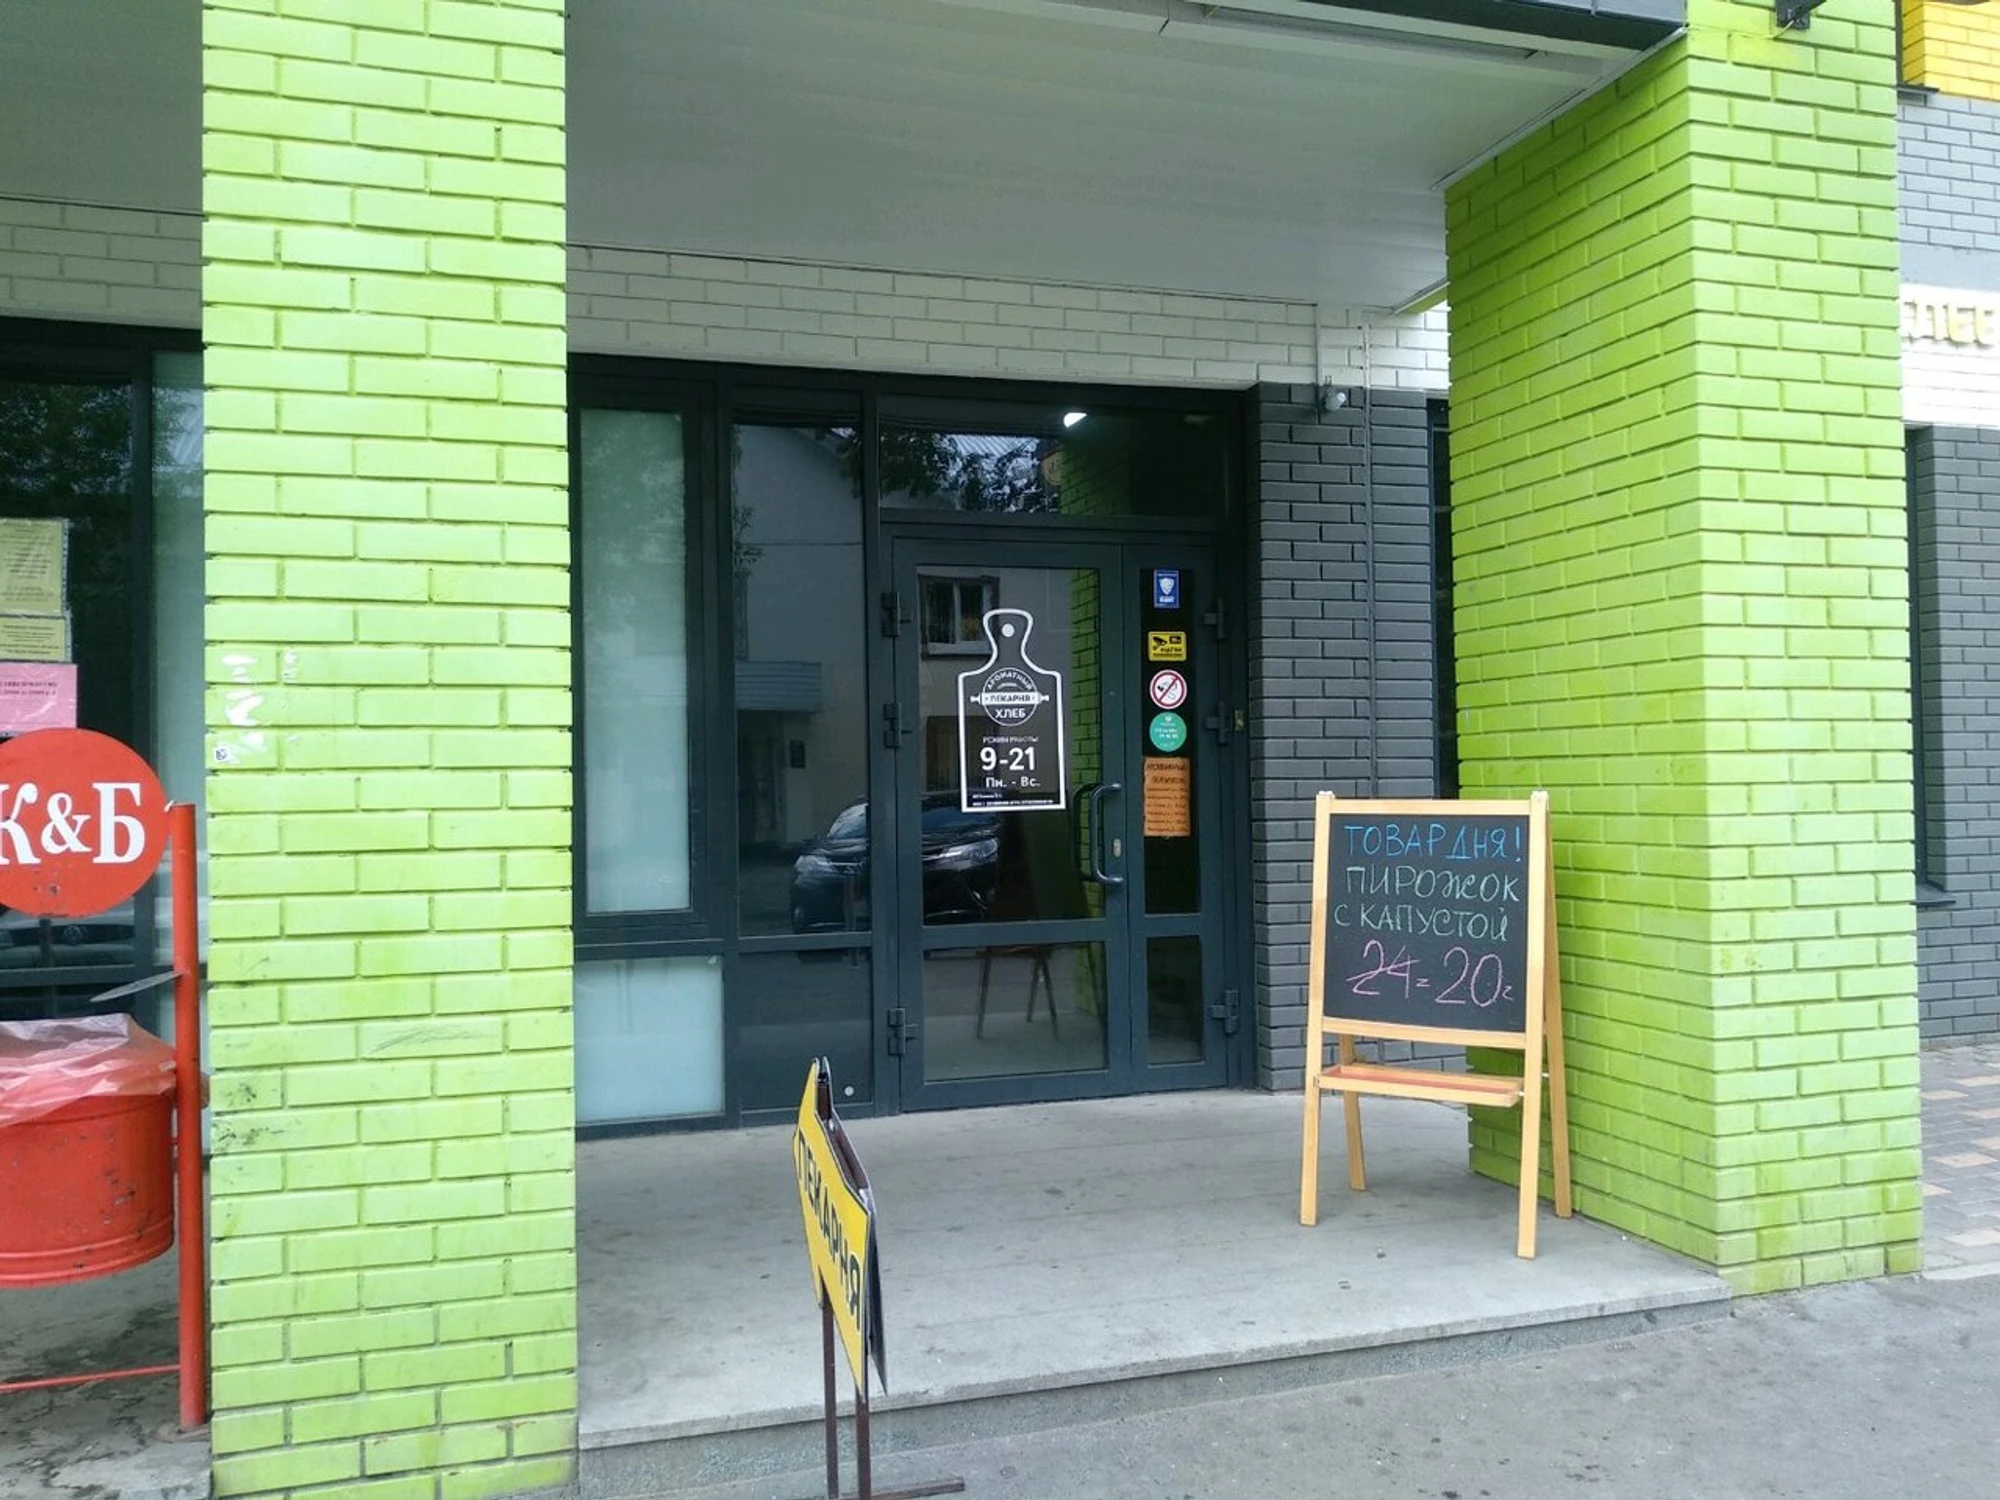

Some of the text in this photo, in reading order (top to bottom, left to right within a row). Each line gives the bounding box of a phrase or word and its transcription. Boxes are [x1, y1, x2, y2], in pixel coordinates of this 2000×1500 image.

[995, 708, 1026, 718] ХЛЕБ
[980, 746, 1035, 771] 9-21
[985, 776, 1007, 788] Пн.
[1020, 775, 1041, 788] Вс.
[1344, 823, 1522, 863] ТОВАР ДНЯ!
[1346, 865, 1520, 903] ПИРОЖОК
[1360, 903, 1508, 942] КАПУСТОЙ
[797, 1130, 862, 1331] ПЕКАРНЯ
